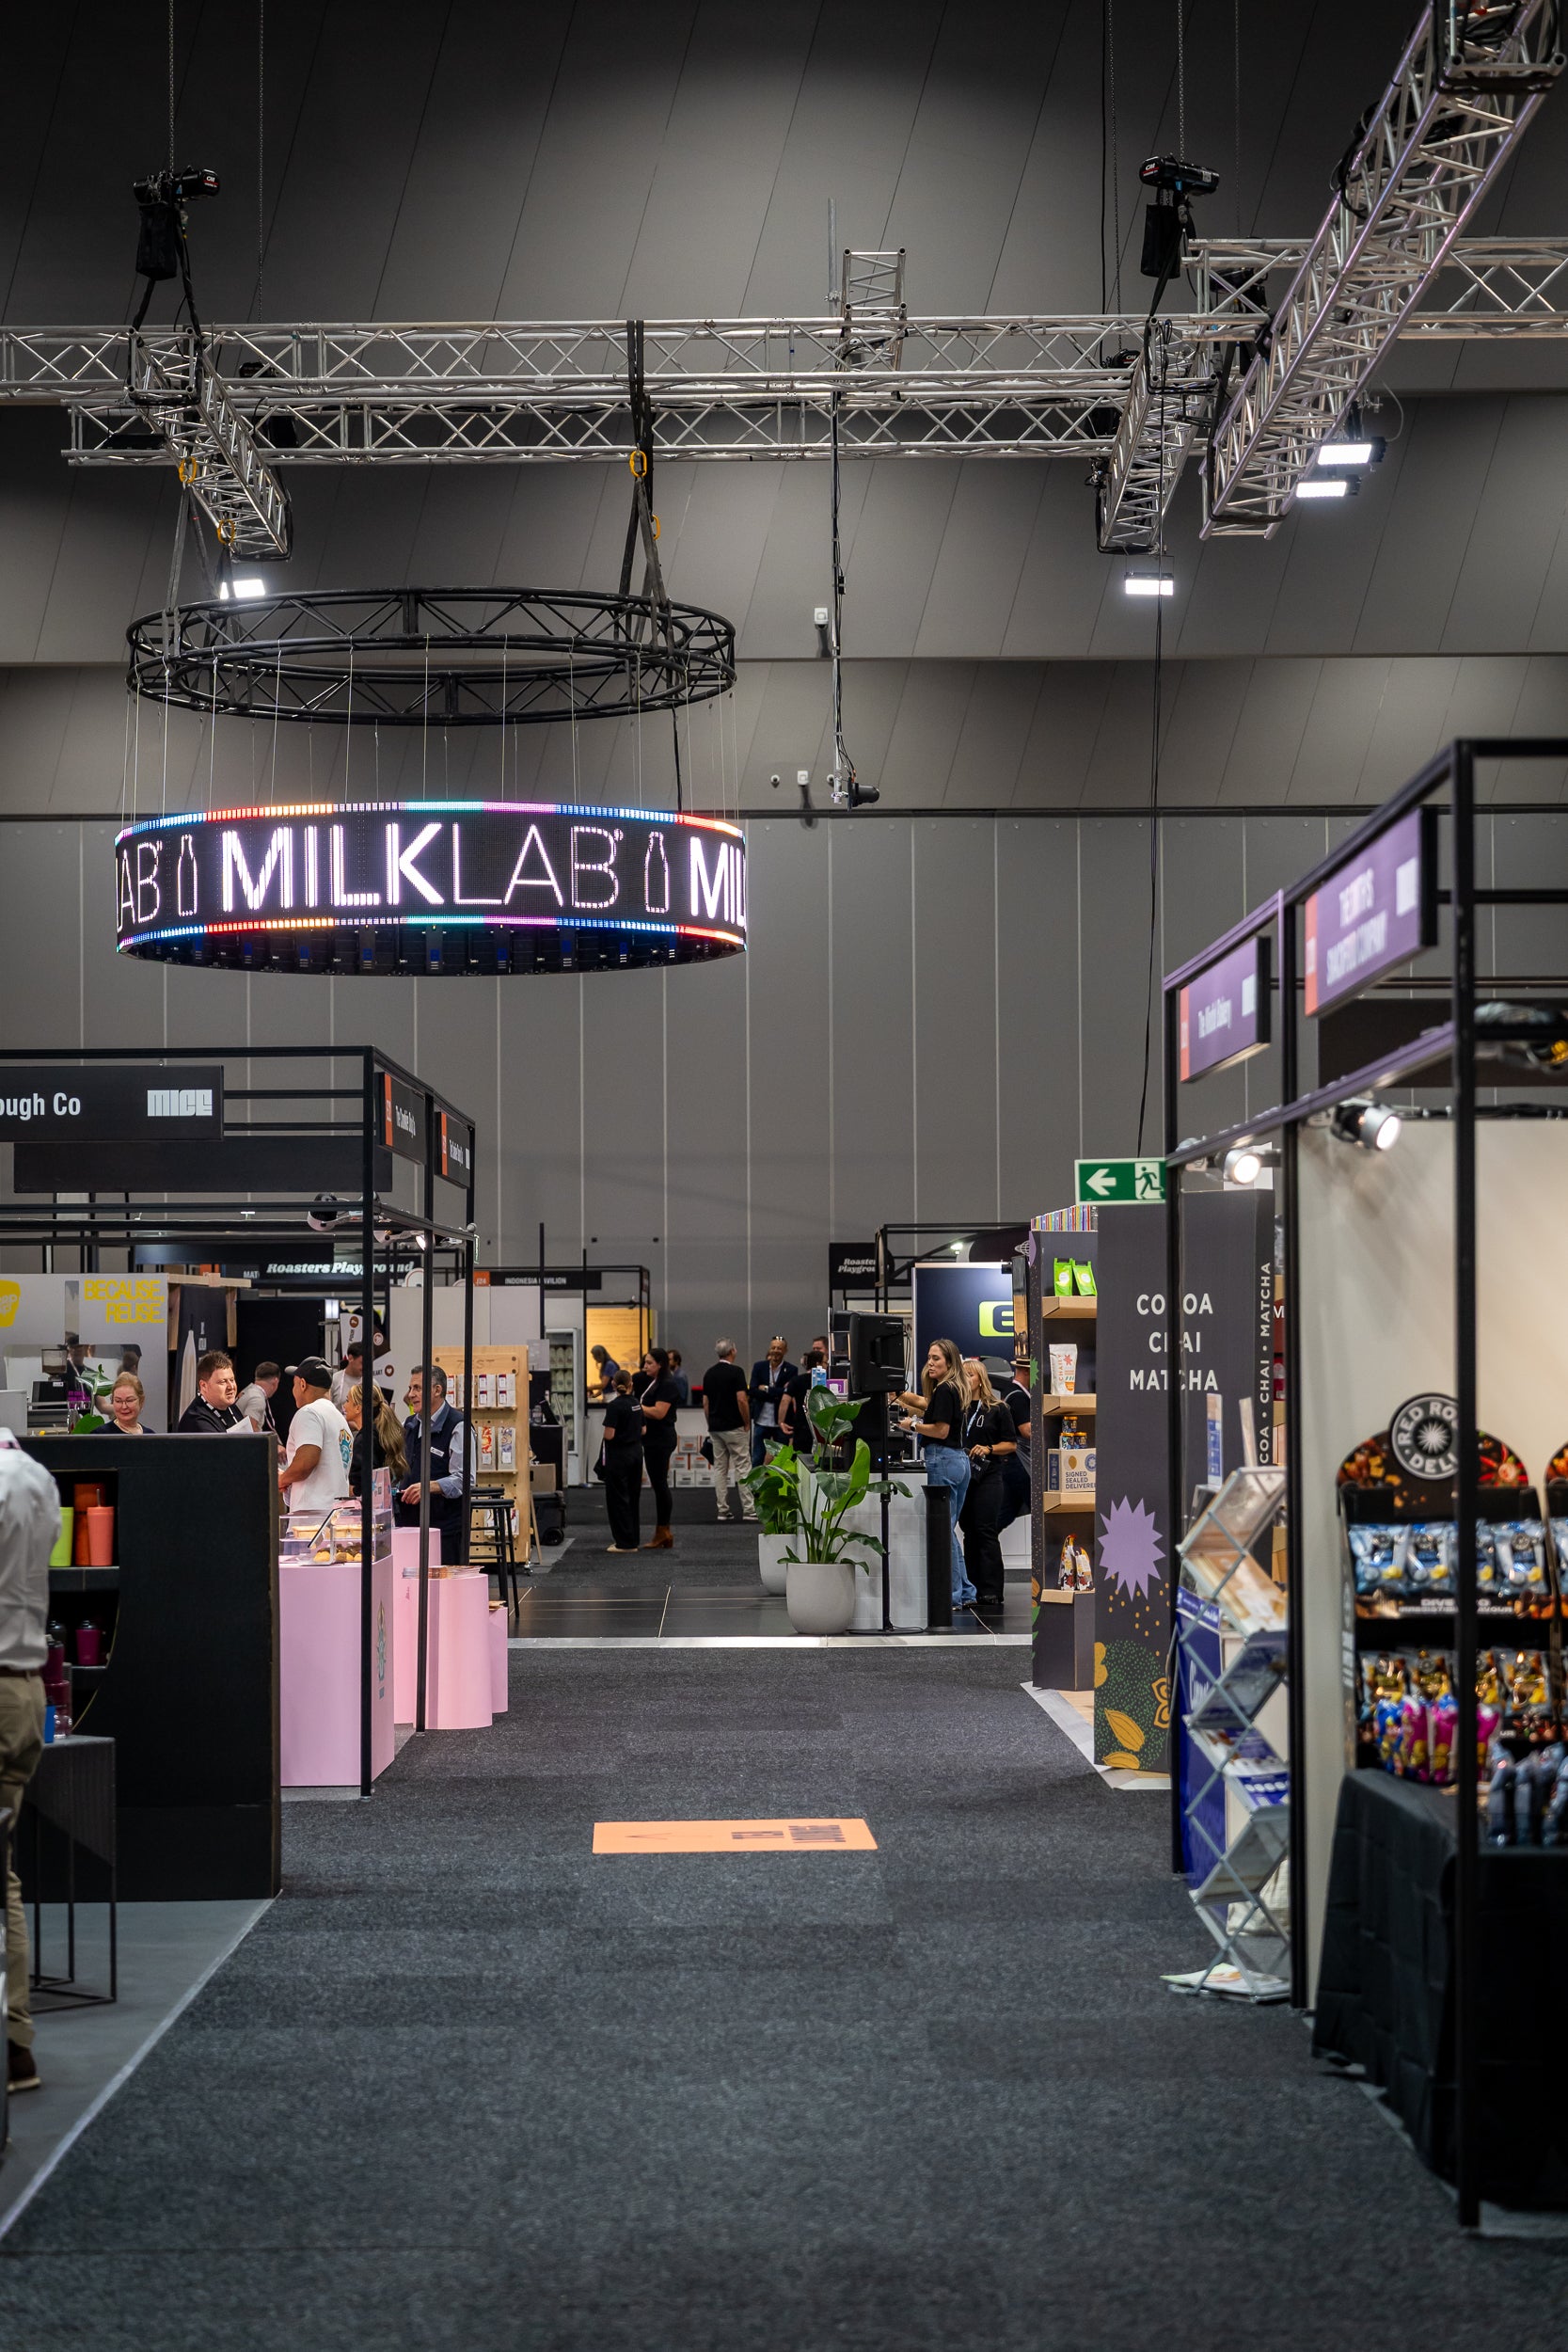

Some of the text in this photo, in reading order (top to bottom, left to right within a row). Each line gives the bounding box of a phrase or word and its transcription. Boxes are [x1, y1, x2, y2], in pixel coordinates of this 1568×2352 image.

[689, 836, 746, 931] MIL
[53, 1092, 81, 1116] Co
[331, 1261, 414, 1276] Playrond
[838, 1264, 876, 1274] Playgro
[538, 1277, 566, 1285] AVILION
[1136, 1293, 1213, 1315] COOA
[1259, 1263, 1271, 1464] COA CHAI MATCHA
[1130, 1369, 1218, 1391] MATHA
[1397, 1406, 1424, 1446] RED
